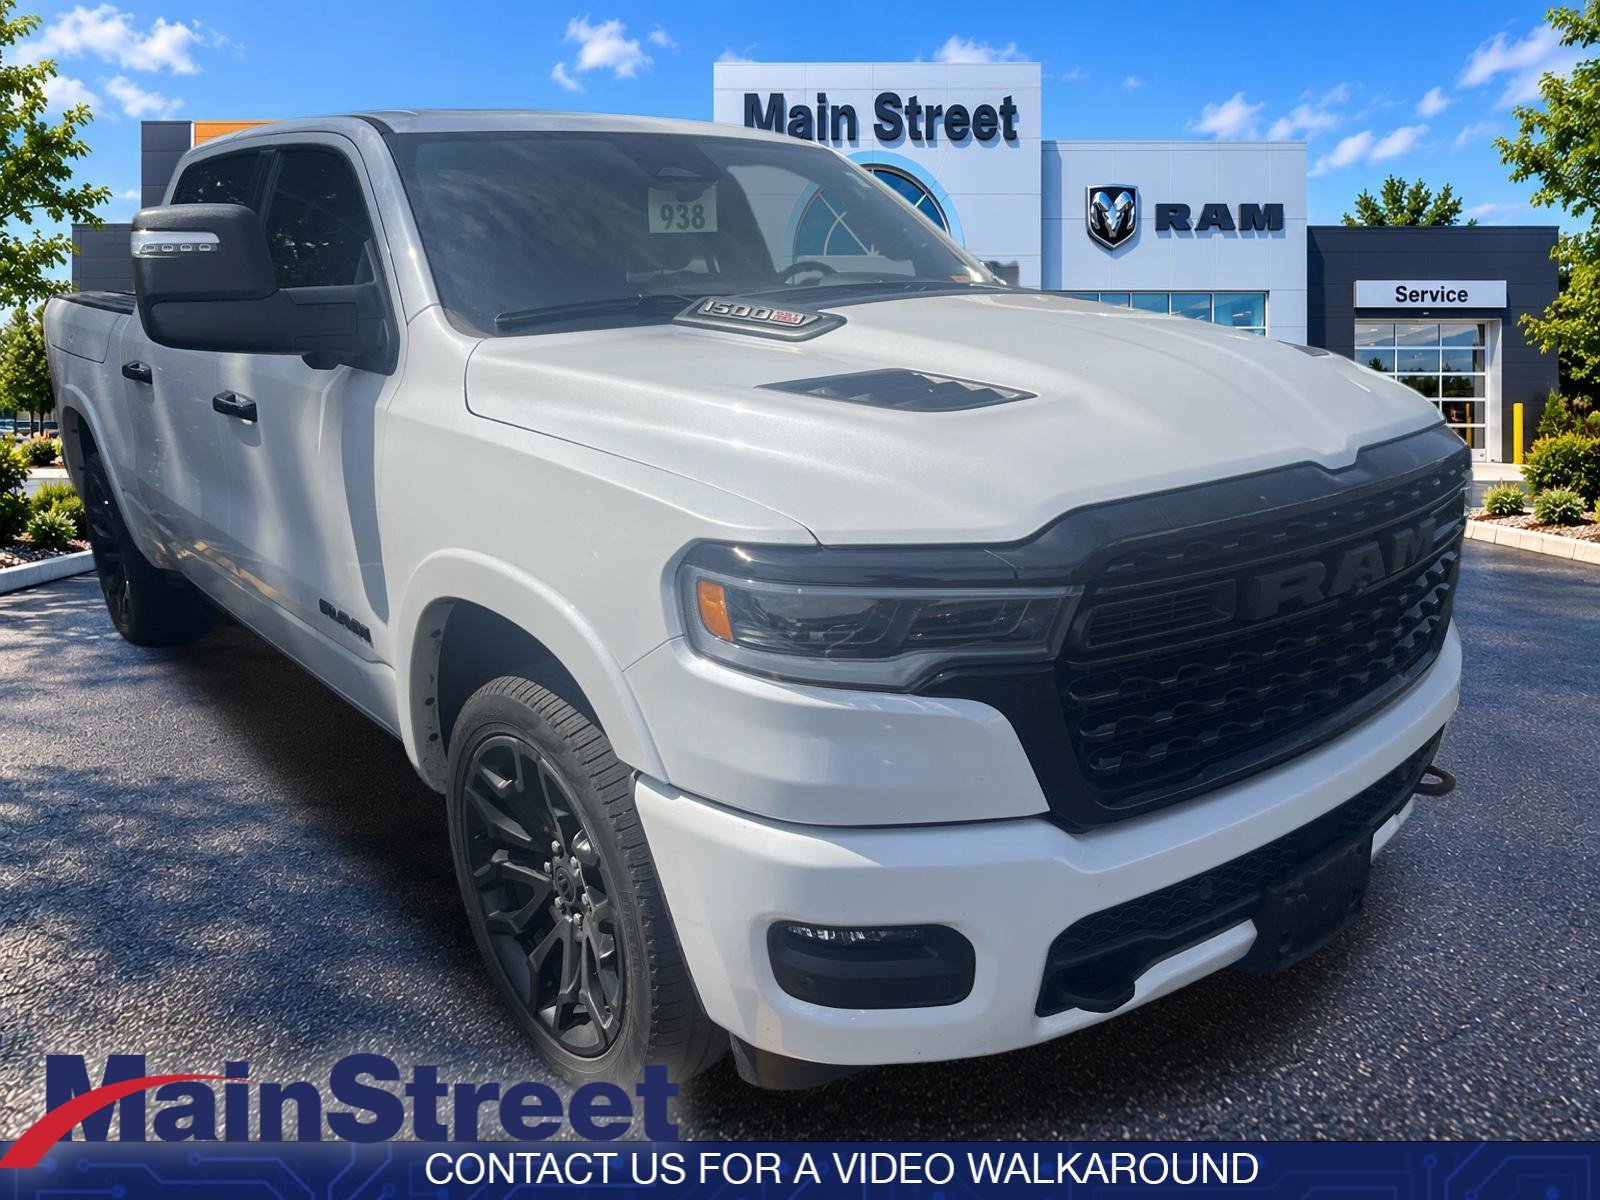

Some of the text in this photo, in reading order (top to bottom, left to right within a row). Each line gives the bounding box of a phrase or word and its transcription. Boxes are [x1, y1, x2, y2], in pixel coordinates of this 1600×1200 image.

[744, 91, 1017, 141] Main Street
[660, 204, 706, 231] 938
[1155, 203, 1284, 232] RAM
[1395, 285, 1469, 303] Service
[702, 299, 773, 321] 1500
[1238, 515, 1437, 622] RAM
